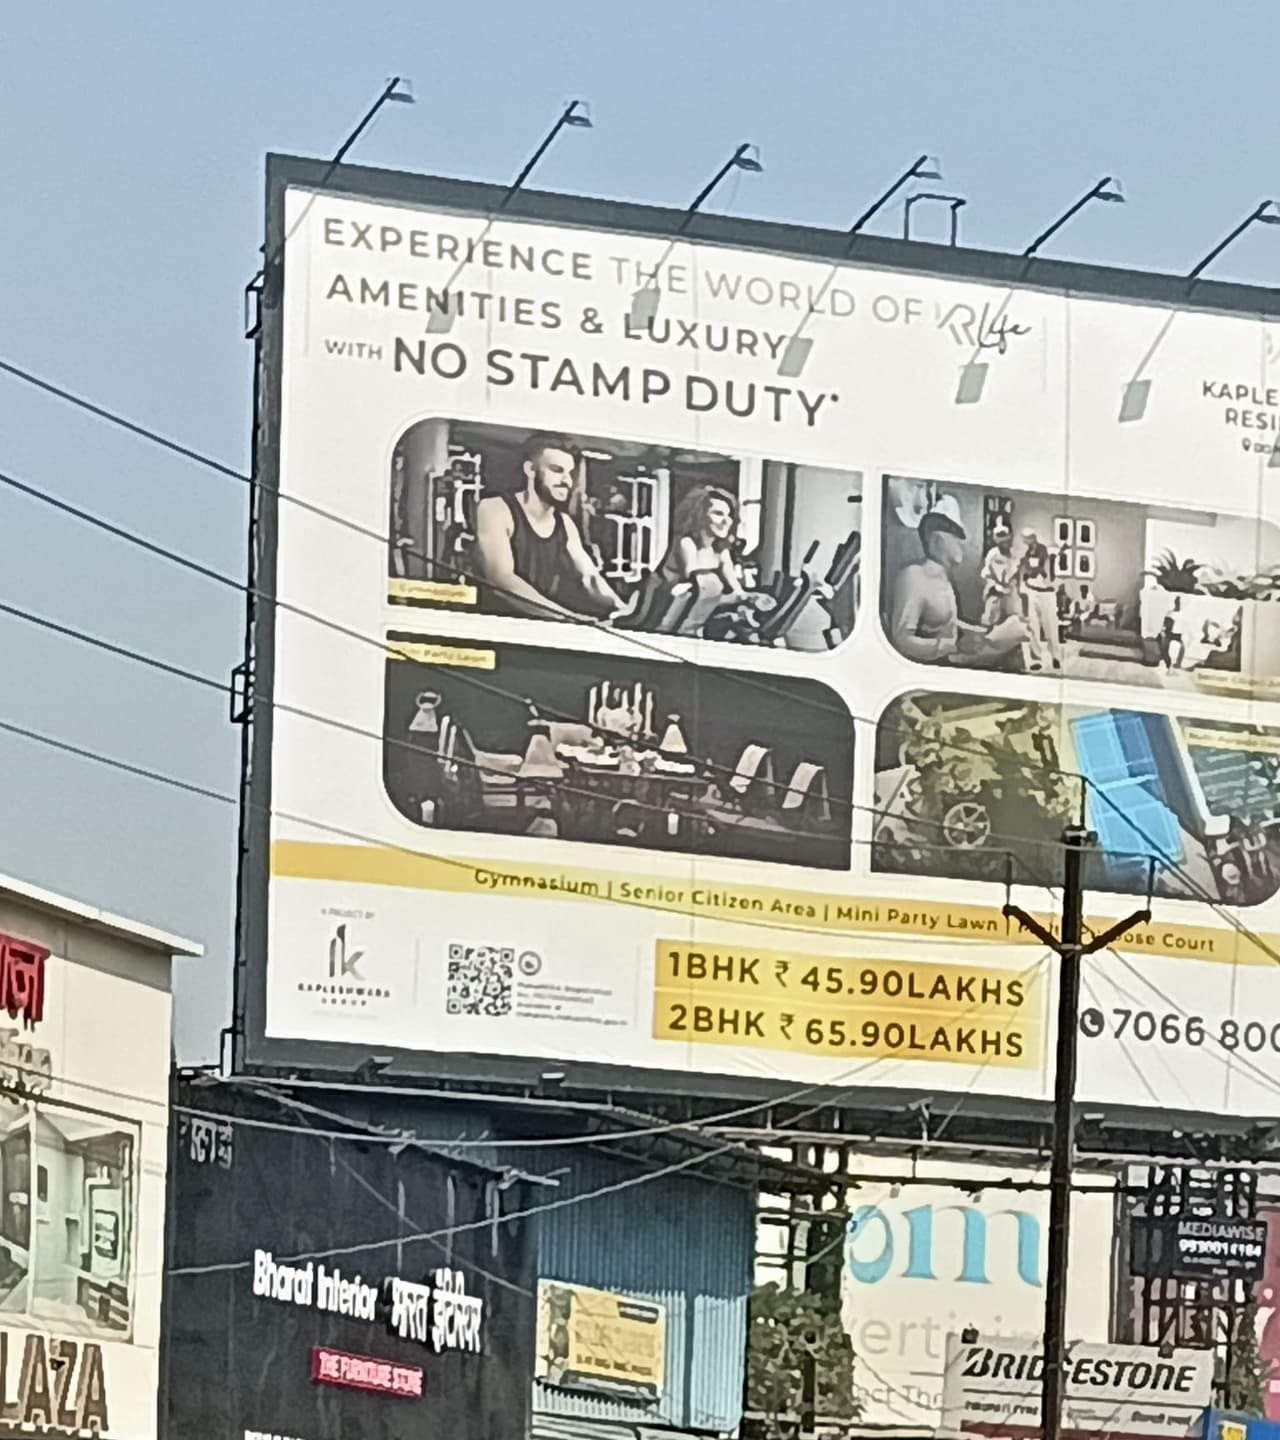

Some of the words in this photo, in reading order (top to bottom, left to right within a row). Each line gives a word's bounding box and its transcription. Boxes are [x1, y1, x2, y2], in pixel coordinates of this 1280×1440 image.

[324, 217, 593, 280] EXPERIENCE
[608, 256, 689, 294] THE
[704, 269, 856, 317] WORLD
[872, 295, 924, 325] OF
[325, 273, 562, 330] AMENITIES
[580, 307, 604, 334] &
[624, 312, 788, 360] LUXURY
[324, 339, 383, 361] WITH
[394, 337, 468, 380] NO
[486, 348, 671, 403] STAMP
[473, 868, 599, 897] Gymnasium
[619, 883, 684, 905] Senior
[691, 889, 764, 912] Citizen
[771, 898, 816, 918] Area
[837, 905, 881, 923] Mini
[888, 908, 941, 931] Party
[947, 914, 998, 934] Lawn
[1163, 932, 1215, 952] Court
[669, 951, 760, 986] 1BHK
[774, 962, 791, 989] ₹
[801, 963, 1025, 1007] 45.90LAKHS
[668, 1004, 766, 1038] 2BHK
[778, 1013, 795, 1041] ₹
[806, 1018, 1024, 1058] 65.90LAKHS
[1113, 1007, 1205, 1047] 7066
[1177, 1221, 1265, 1242] MEDIAWISE
[253, 1248, 314, 1306] Bharat
[317, 1264, 378, 1321] Interior
[961, 1347, 1197, 1393] BRIDESTONE
